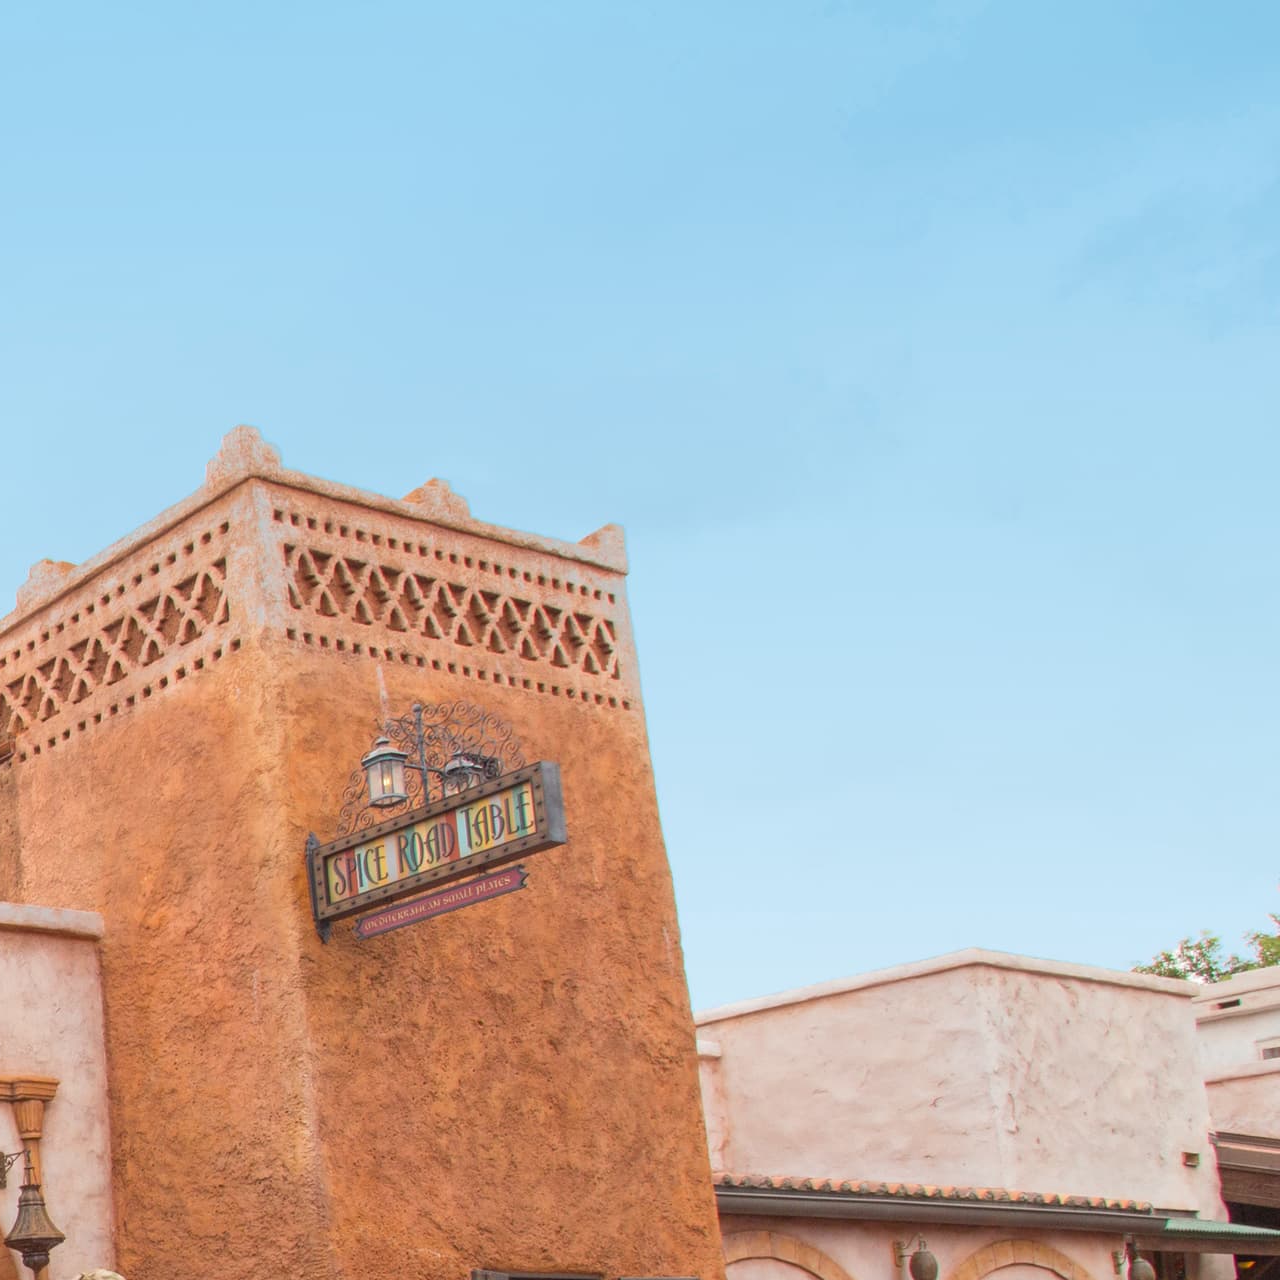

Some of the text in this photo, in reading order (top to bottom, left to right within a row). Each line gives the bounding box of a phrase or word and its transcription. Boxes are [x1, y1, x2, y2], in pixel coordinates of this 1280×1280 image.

[333, 791, 534, 896] SPICE ROAD TABLE
